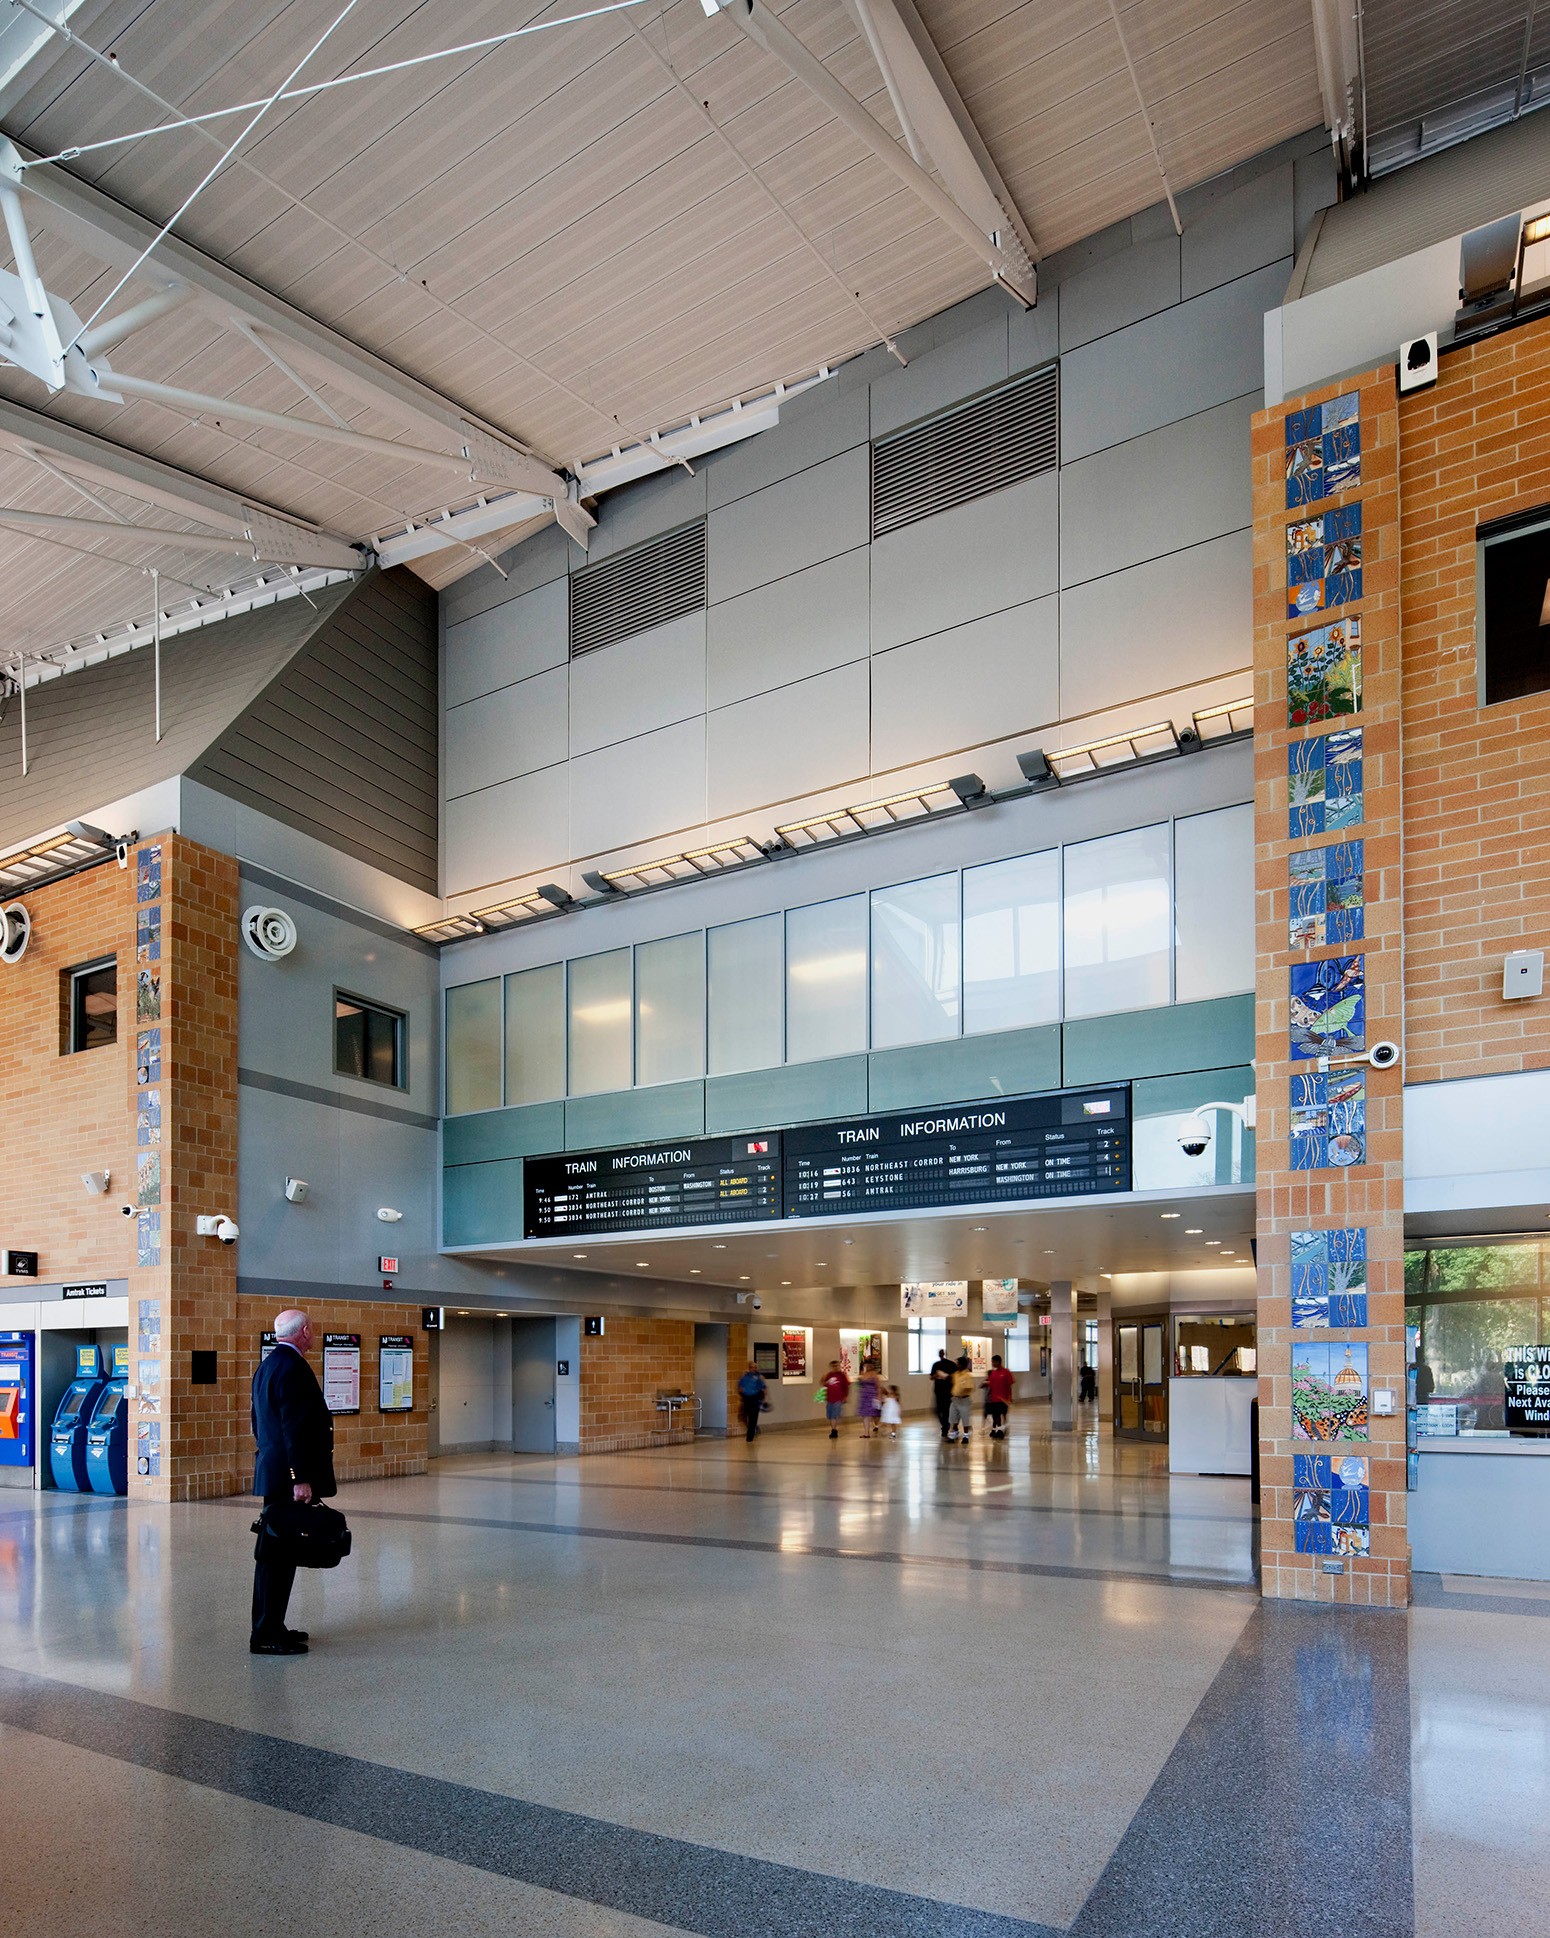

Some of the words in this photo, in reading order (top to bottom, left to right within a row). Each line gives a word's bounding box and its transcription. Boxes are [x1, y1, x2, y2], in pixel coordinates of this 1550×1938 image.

[838, 1128, 879, 1144] TRAIN
[900, 1112, 1006, 1136] INFORMATION
[565, 1161, 597, 1174] TRAIN
[612, 1150, 691, 1169] INFORMATION
[865, 1160, 908, 1171] NORTHEAST
[799, 1181, 818, 1190] 10:19
[842, 1178, 855, 1186] 643
[865, 1173, 903, 1183] KEYSTONE
[949, 1165, 987, 1176] HARRISBURG
[684, 1181, 712, 1189] WASHINGTON
[799, 1193, 818, 1201] 10:27
[866, 1186, 894, 1195] AMTRAK
[996, 1174, 1034, 1184] WASHINGTON
[1057, 1170, 1071, 1178] TIME
[586, 1200, 618, 1209] NORTHEAST
[586, 1210, 618, 1219] NORTHEAST
[384, 1258, 396, 1270] EXIT
[66, 1288, 85, 1297] Amtrak
[1515, 1365, 1524, 1379] is
[1517, 1385, 1550, 1395] Please
[1508, 1397, 1532, 1407] Next
